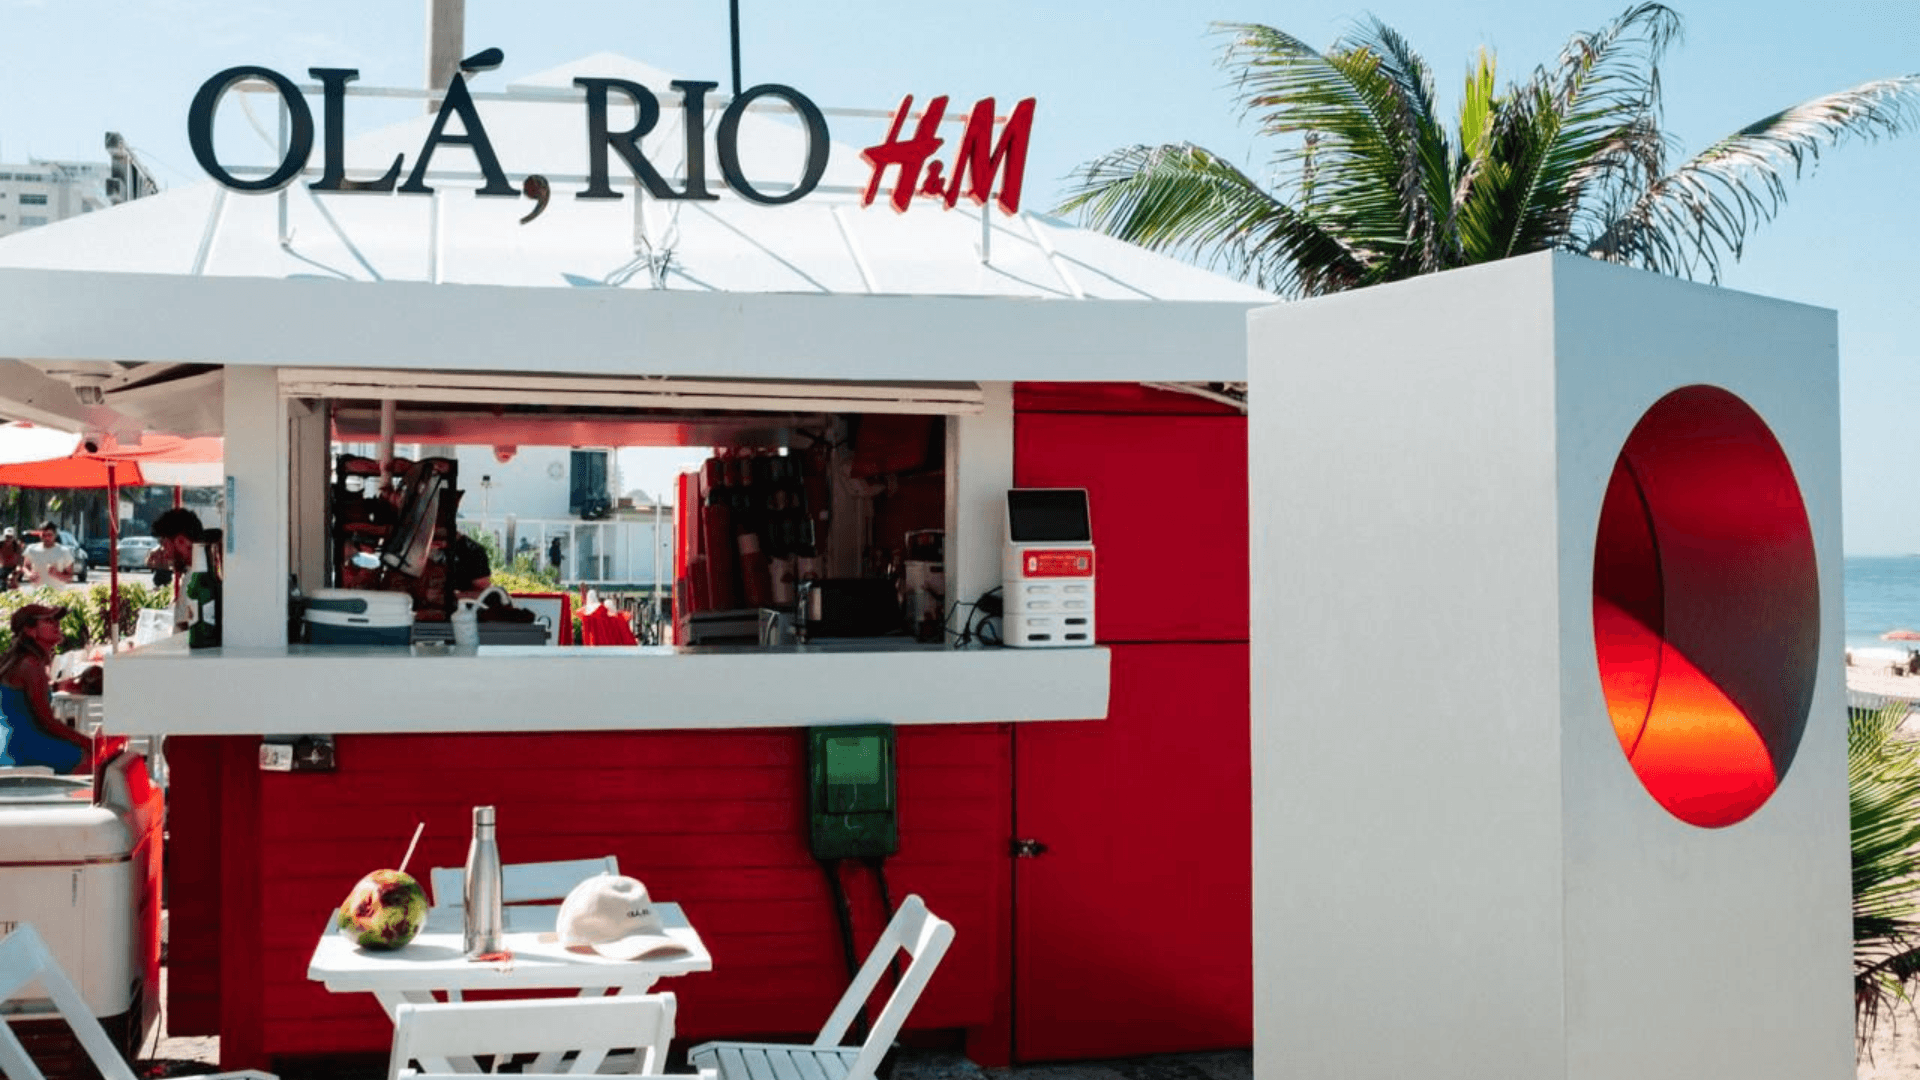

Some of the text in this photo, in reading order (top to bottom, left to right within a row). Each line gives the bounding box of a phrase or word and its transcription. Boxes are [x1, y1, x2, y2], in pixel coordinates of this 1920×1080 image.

[188, 48, 1036, 224] OLÁ, RIO H&M
